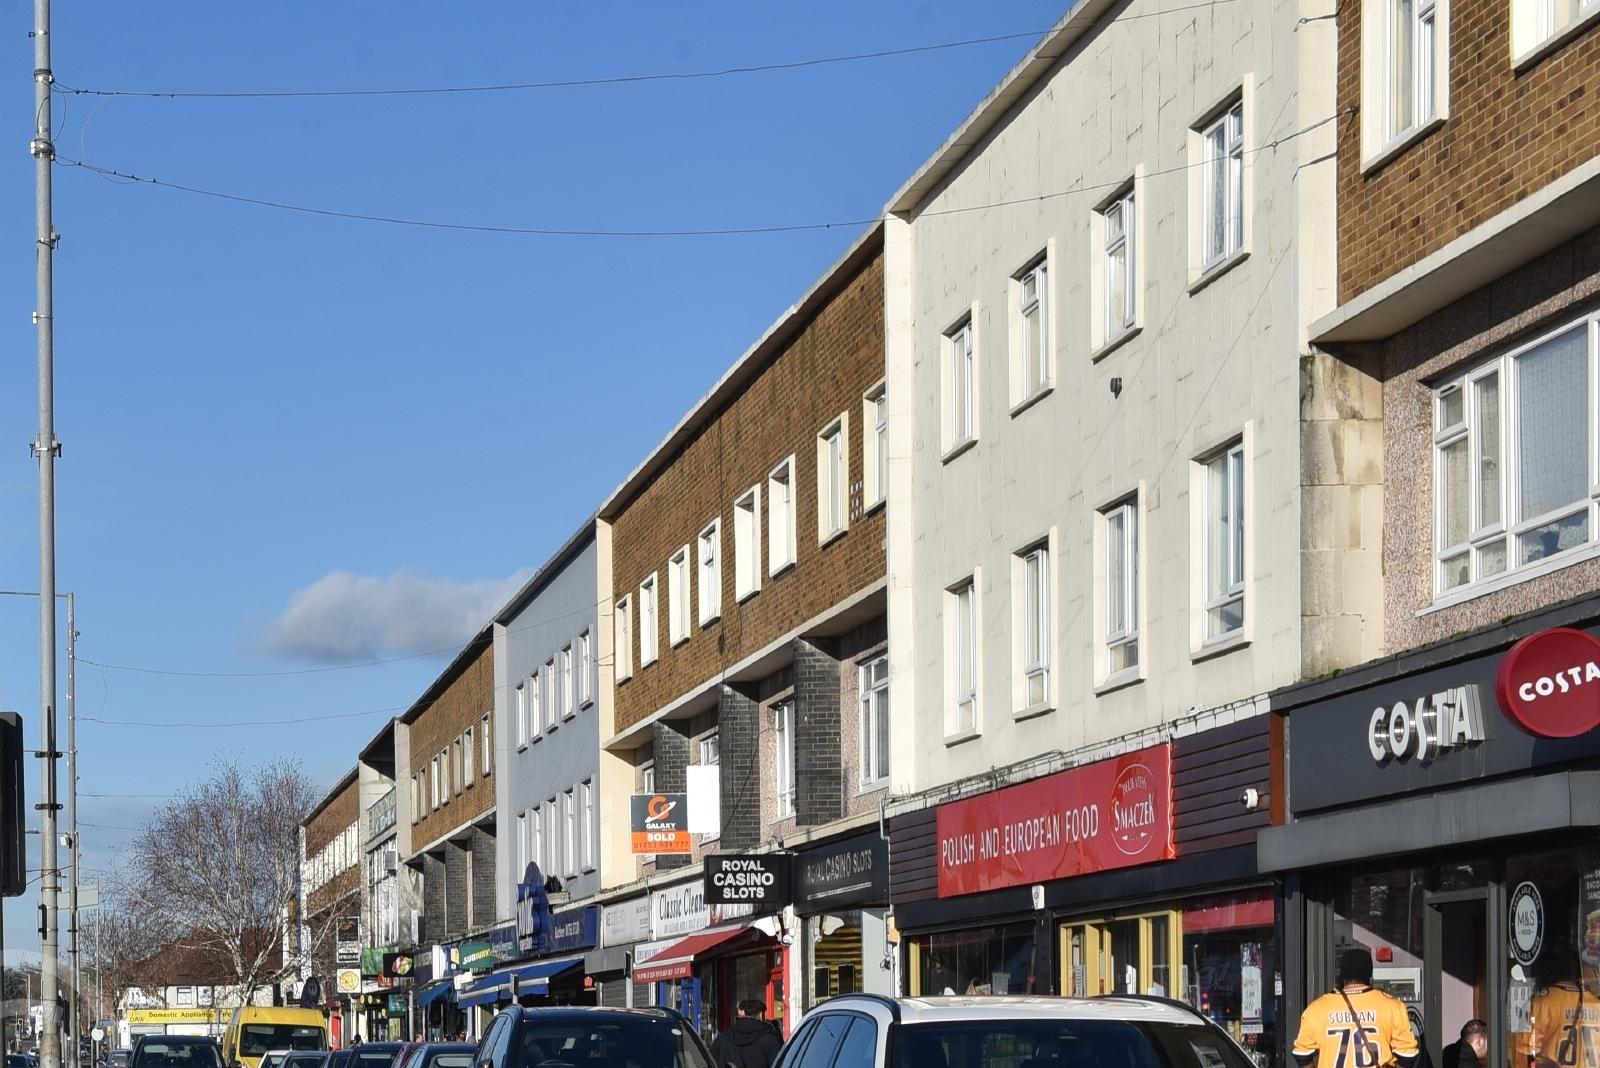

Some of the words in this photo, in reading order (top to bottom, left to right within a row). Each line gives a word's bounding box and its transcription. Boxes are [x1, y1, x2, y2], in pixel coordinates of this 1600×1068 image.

[1518, 661, 1600, 702] COSTA
[1368, 684, 1485, 762] COSTA
[647, 833, 676, 842] SOLD
[942, 836, 975, 867] POLISH
[979, 828, 999, 860] AND
[1004, 813, 1060, 855] EUROPEAN
[1065, 804, 1099, 841] FOOD
[722, 860, 765, 871] ROYAL
[808, 863, 825, 884] ROYAL
[825, 853, 851, 882] CASINO
[852, 849, 872, 874] SLOTS
[713, 872, 774, 886] CASINO
[722, 886, 765, 899] SLOTS
[659, 893, 682, 921] Classic
[683, 888, 707, 915] Clean
[1517, 910, 1535, 927] M&S
[462, 948, 492, 965] SUBWAY
[1328, 1010, 1376, 1024] SUBAN
